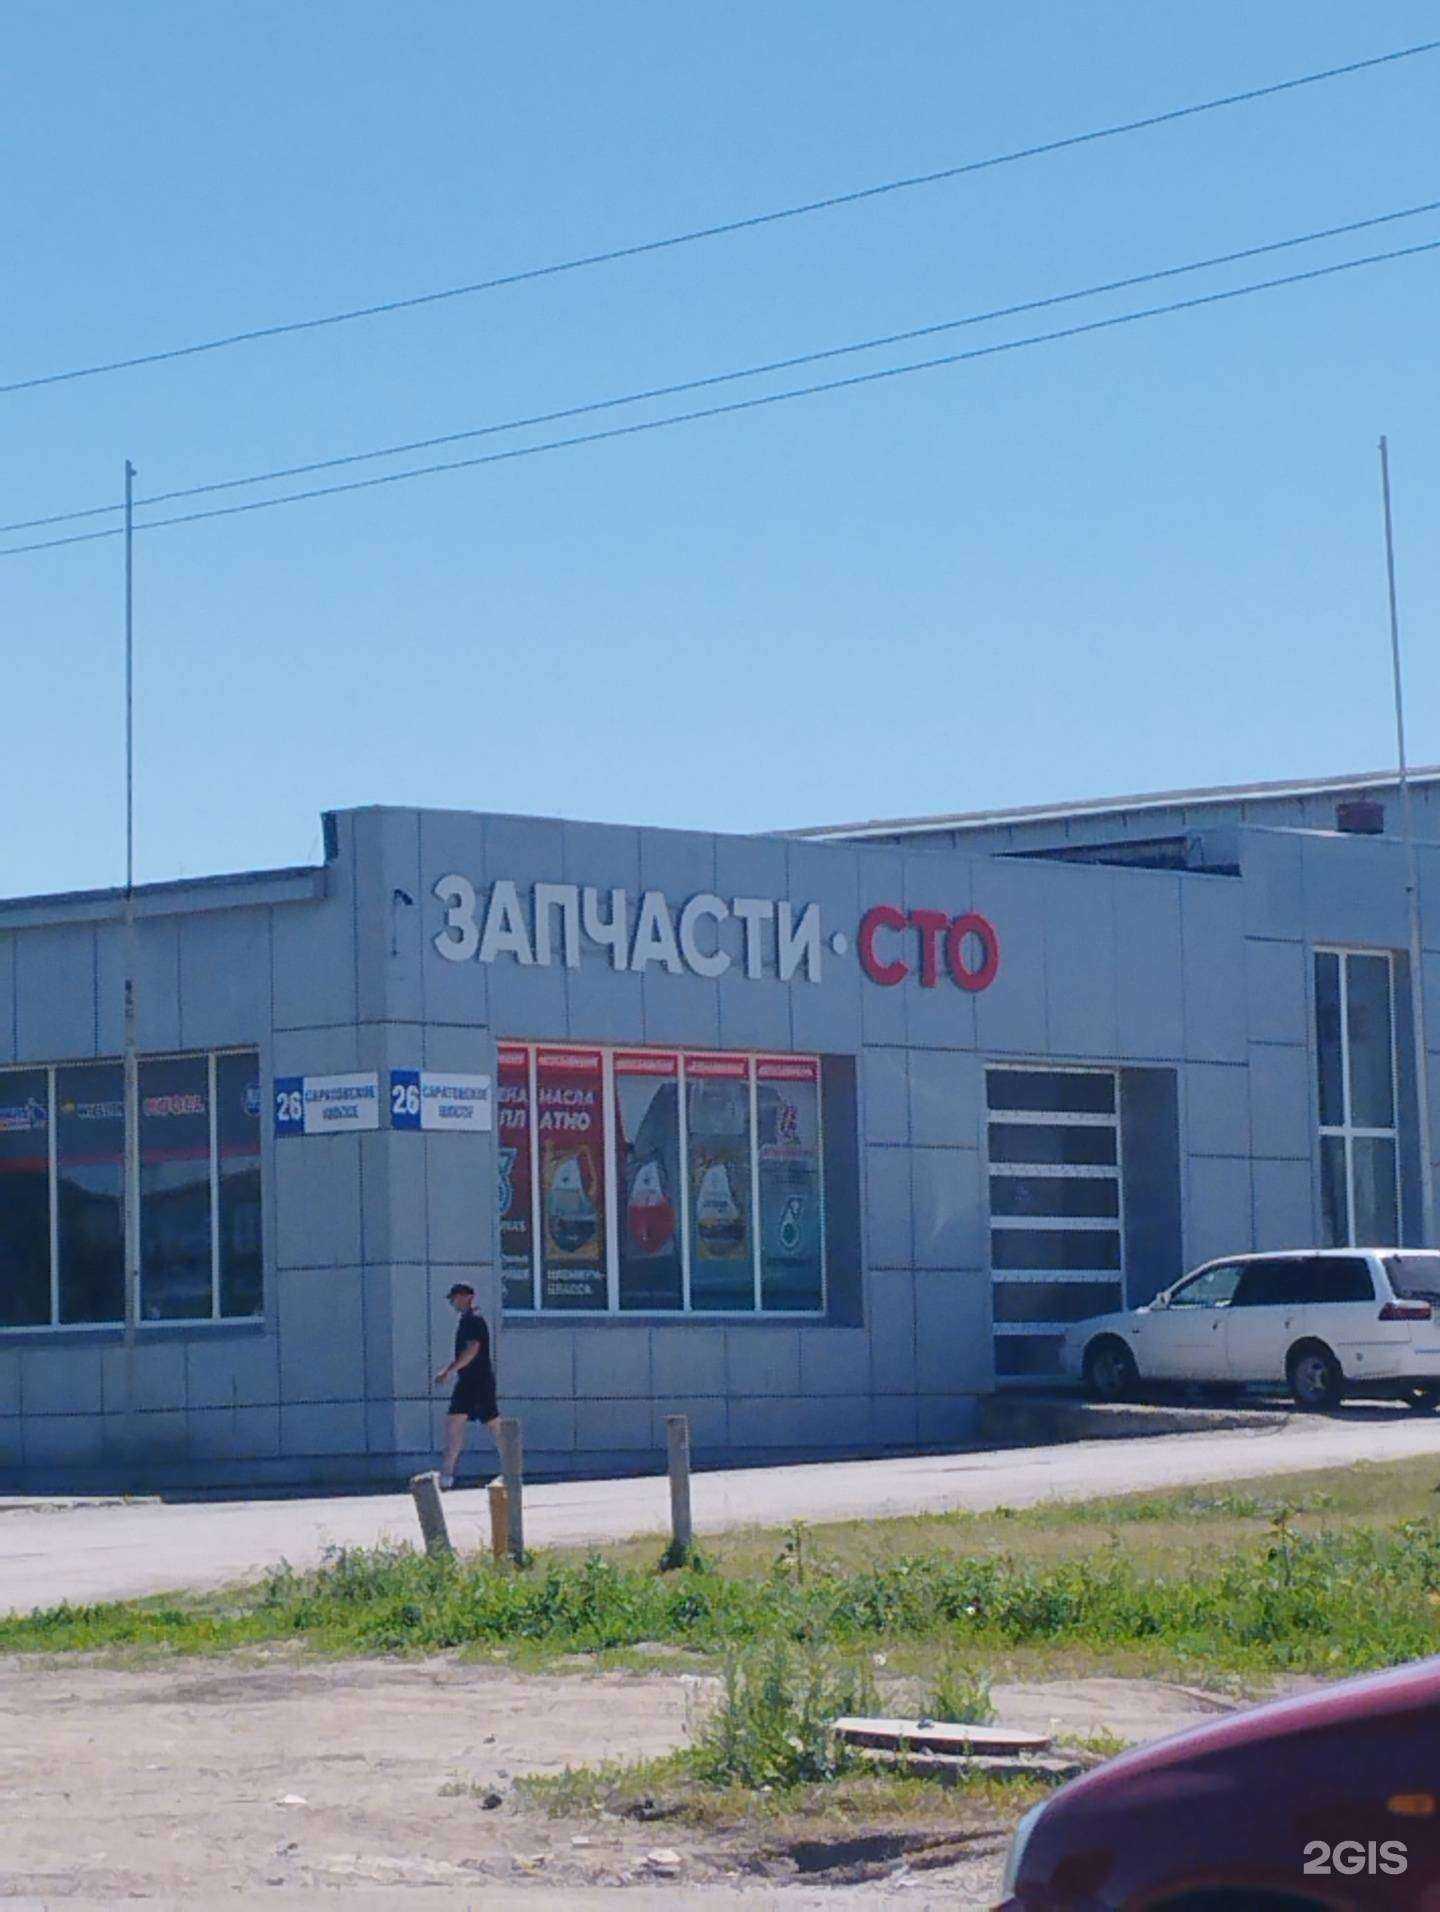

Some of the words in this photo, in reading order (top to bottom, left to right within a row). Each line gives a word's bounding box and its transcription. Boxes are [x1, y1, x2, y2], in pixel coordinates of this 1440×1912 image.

[433, 874, 822, 984] ЗАПЧАСТИ
[858, 905, 999, 992] СТО
[277, 1091, 302, 1120] 26
[392, 1085, 419, 1114] 26
